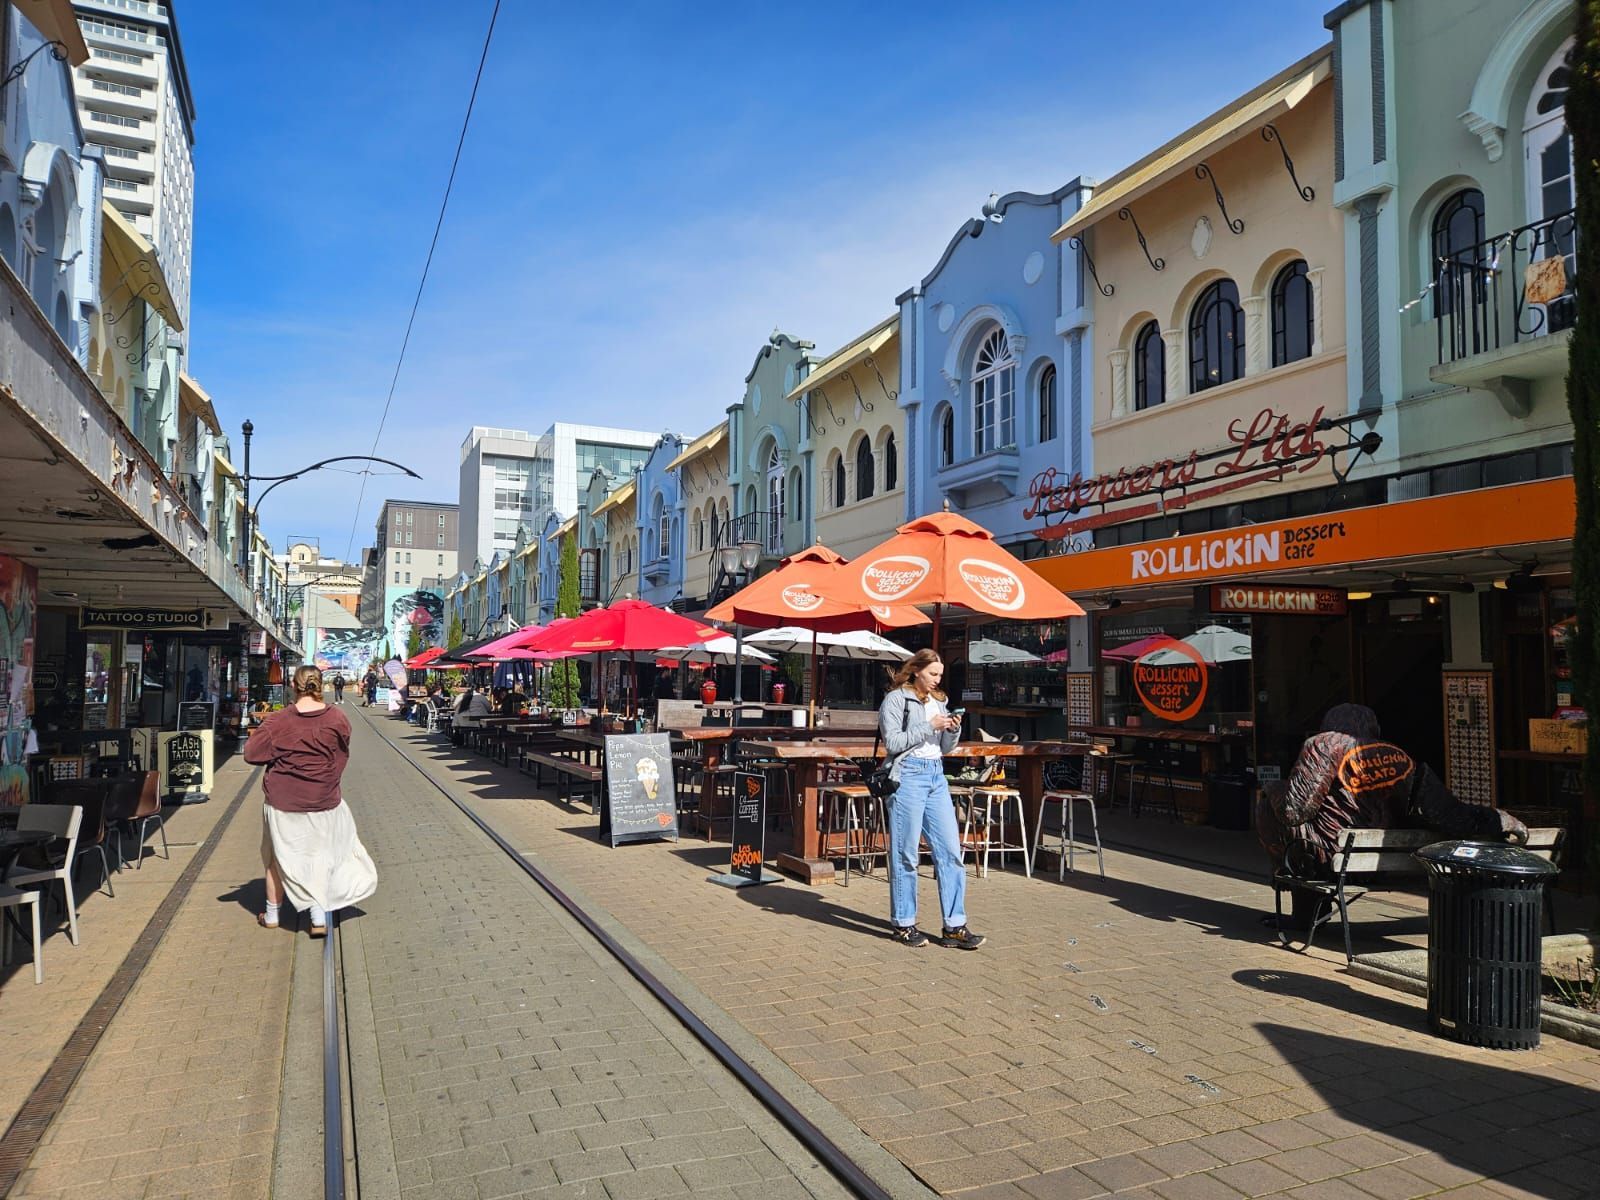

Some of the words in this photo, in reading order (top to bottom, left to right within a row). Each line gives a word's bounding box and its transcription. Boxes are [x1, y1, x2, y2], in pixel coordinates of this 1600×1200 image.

[1215, 406, 1325, 474] Ltd
[87, 612, 144, 622] TATTOO
[146, 613, 199, 623] STUDIO
[1150, 682, 1190, 696] dessert
[1160, 696, 1181, 710] cafe
[171, 736, 200, 750] FLASH
[171, 750, 200, 759] TATTOO
[1349, 767, 1397, 788] GELATO
[738, 804, 759, 814] COFFEE
